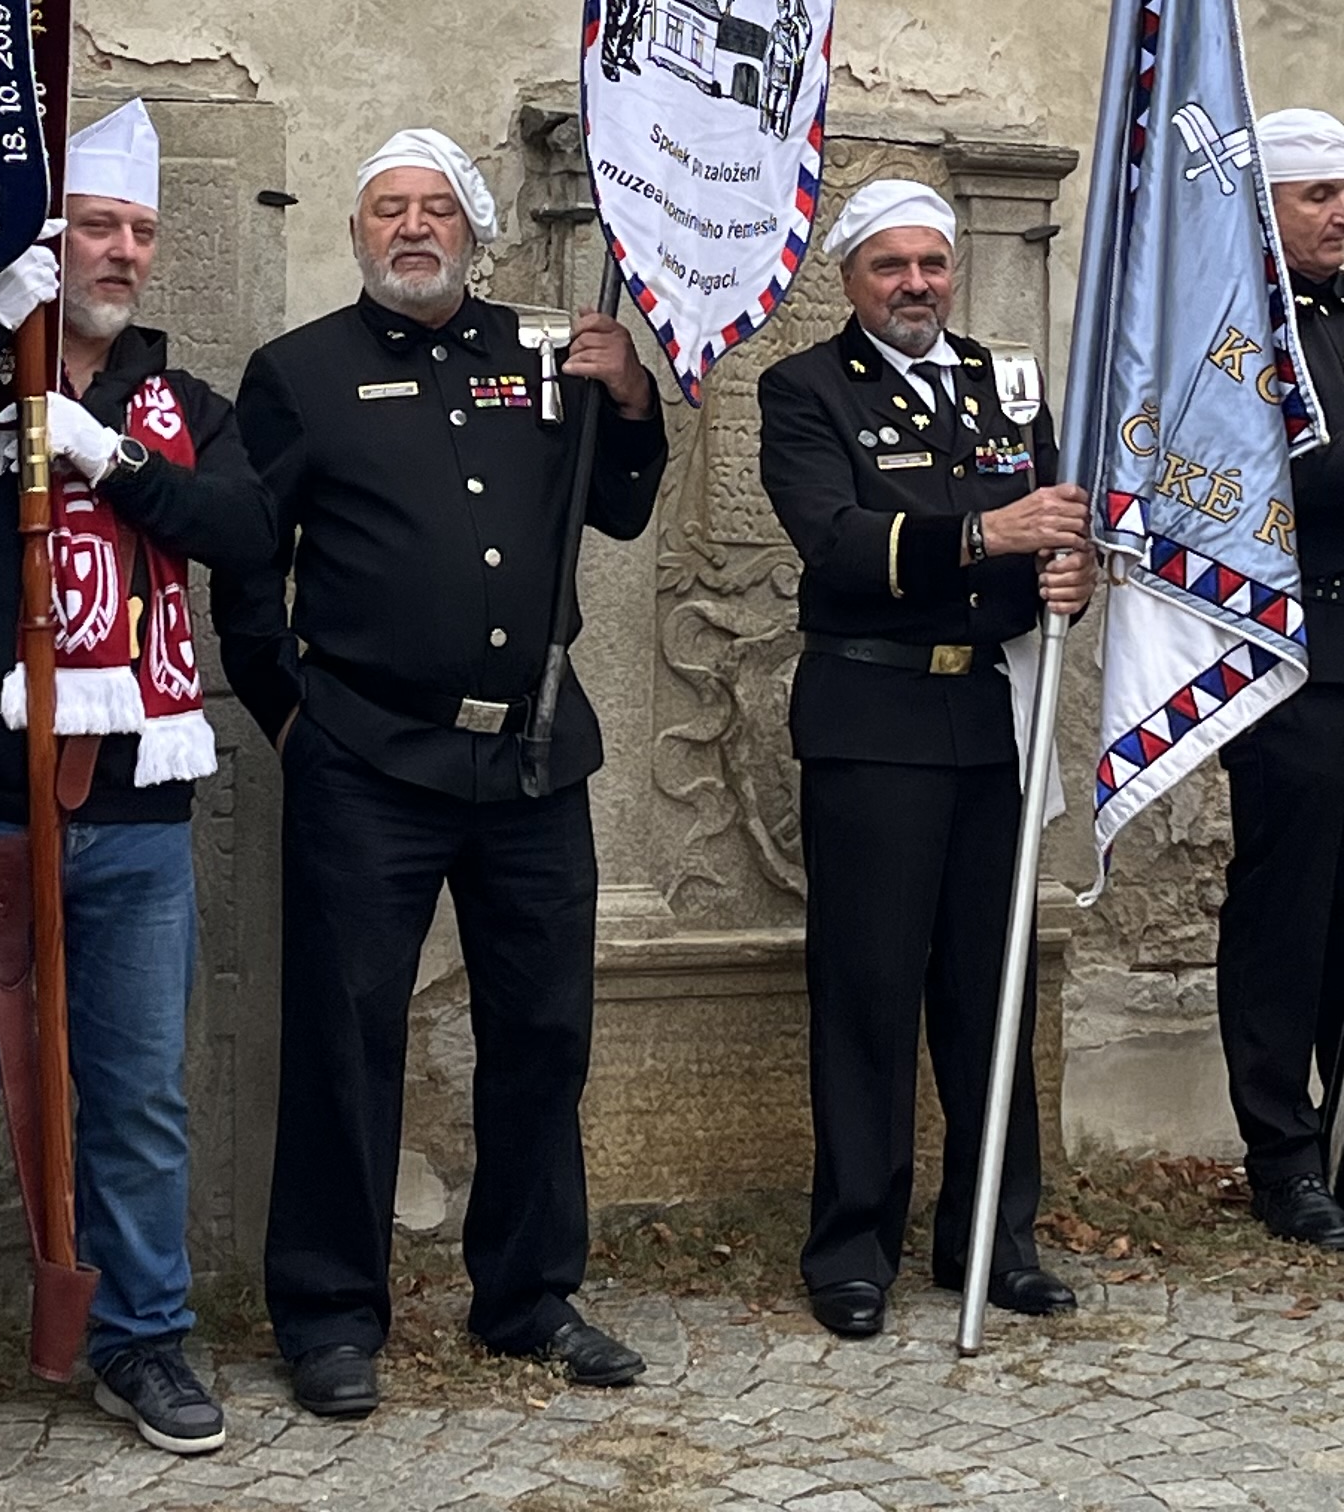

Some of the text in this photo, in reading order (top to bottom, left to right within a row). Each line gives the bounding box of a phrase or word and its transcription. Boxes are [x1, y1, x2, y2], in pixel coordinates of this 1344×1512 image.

[1, 126, 28, 163] 18.
[596, 158, 663, 205] muzea
[704, 160, 762, 183] založení
